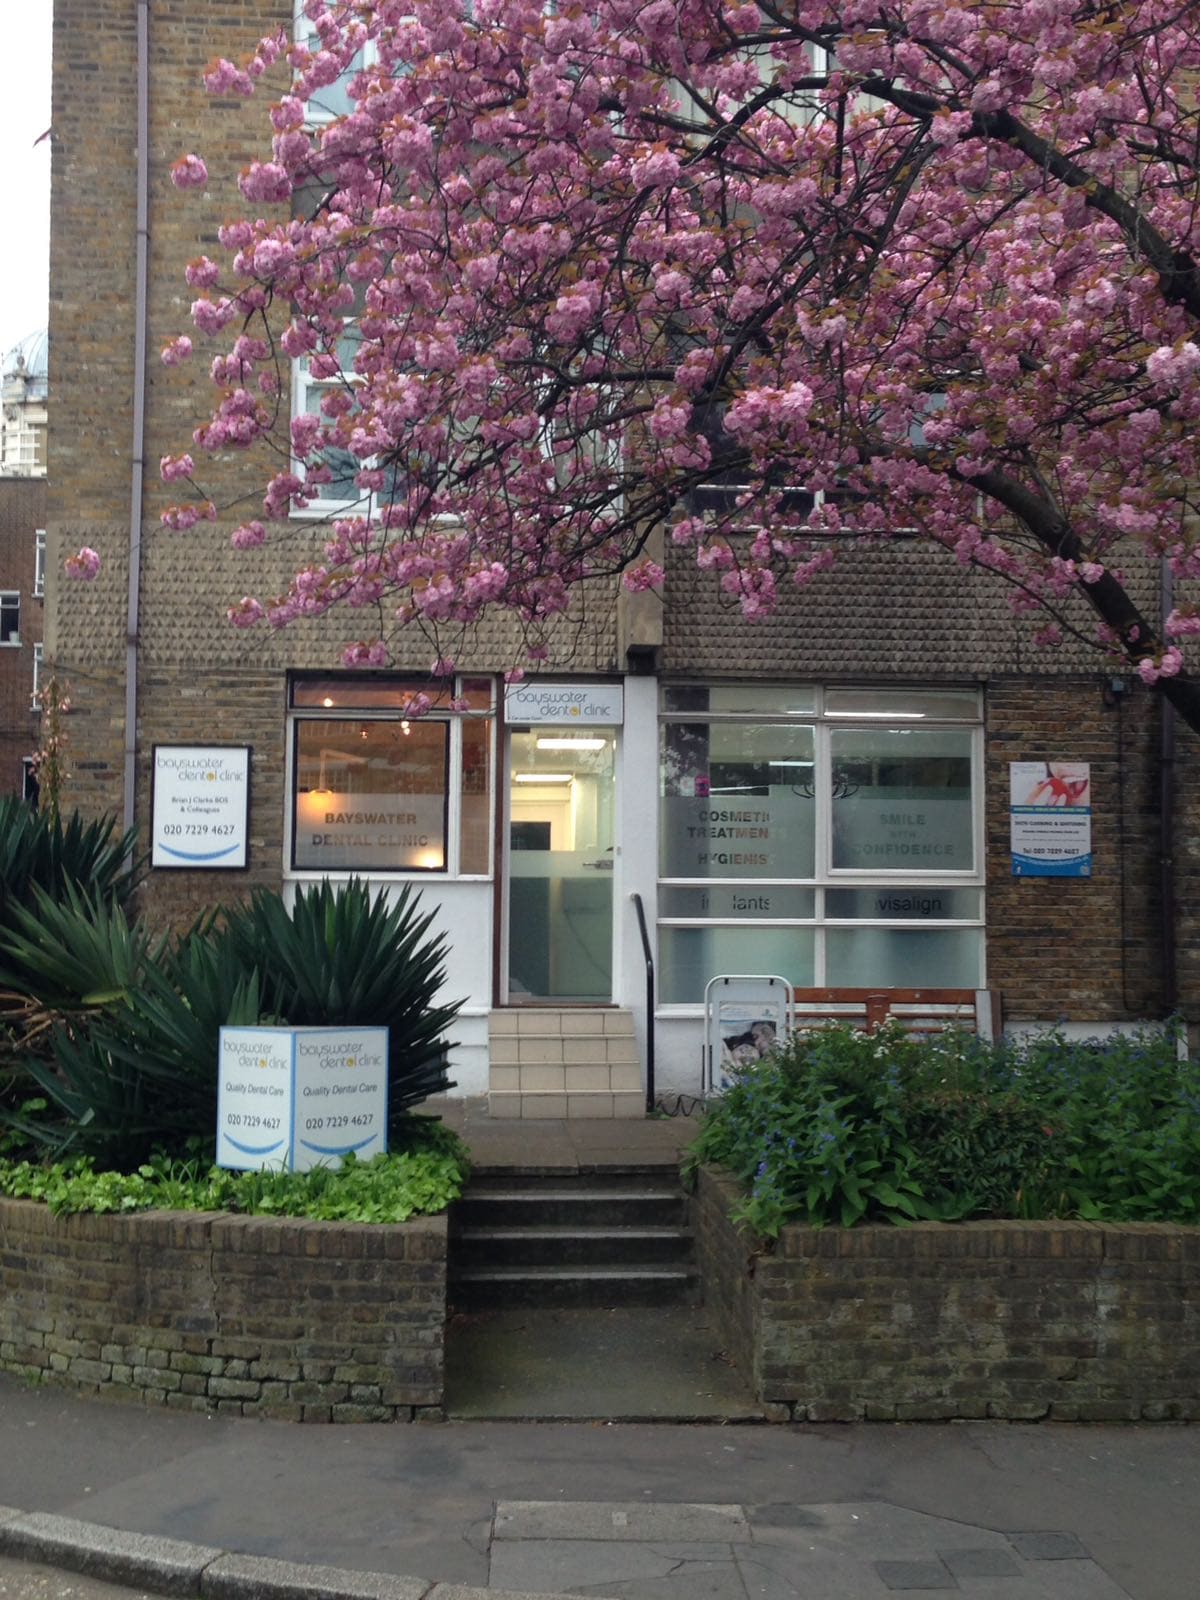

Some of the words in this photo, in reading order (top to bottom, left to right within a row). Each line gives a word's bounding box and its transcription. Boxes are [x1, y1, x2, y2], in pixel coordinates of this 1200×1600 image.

[516, 691, 588, 705] bayswater
[540, 703, 581, 716] dental
[584, 703, 611, 716] clinic
[156, 753, 224, 771] bayswater
[178, 769, 217, 781] dental
[219, 769, 244, 781] clinic
[324, 813, 417, 824] BAYSWATER
[880, 814, 927, 825] SMILE
[164, 824, 182, 835] 020
[185, 824, 208, 835] 7229
[211, 824, 235, 835] 4627
[312, 834, 372, 846] DENTAL
[377, 834, 428, 846] CLINIC
[851, 843, 954, 856] CONFIDENCE
[223, 1038, 273, 1055] bayswater
[299, 1041, 364, 1057] bayswater
[238, 1053, 268, 1069] dental
[269, 1056, 288, 1070] clinic
[319, 1054, 357, 1069] dental
[358, 1053, 382, 1067] clinic
[225, 1082, 247, 1095] Quality
[247, 1083, 268, 1094] Dental
[268, 1085, 284, 1096] Care
[302, 1085, 330, 1097] Quality
[332, 1083, 357, 1095] Dental
[358, 1082, 378, 1093] Care
[227, 1113, 241, 1125] 020
[243, 1115, 261, 1127] 7229
[262, 1117, 281, 1129] 4627
[305, 1118, 324, 1129] 020
[326, 1116, 349, 1128] 7229
[351, 1114, 374, 1126] 4627
